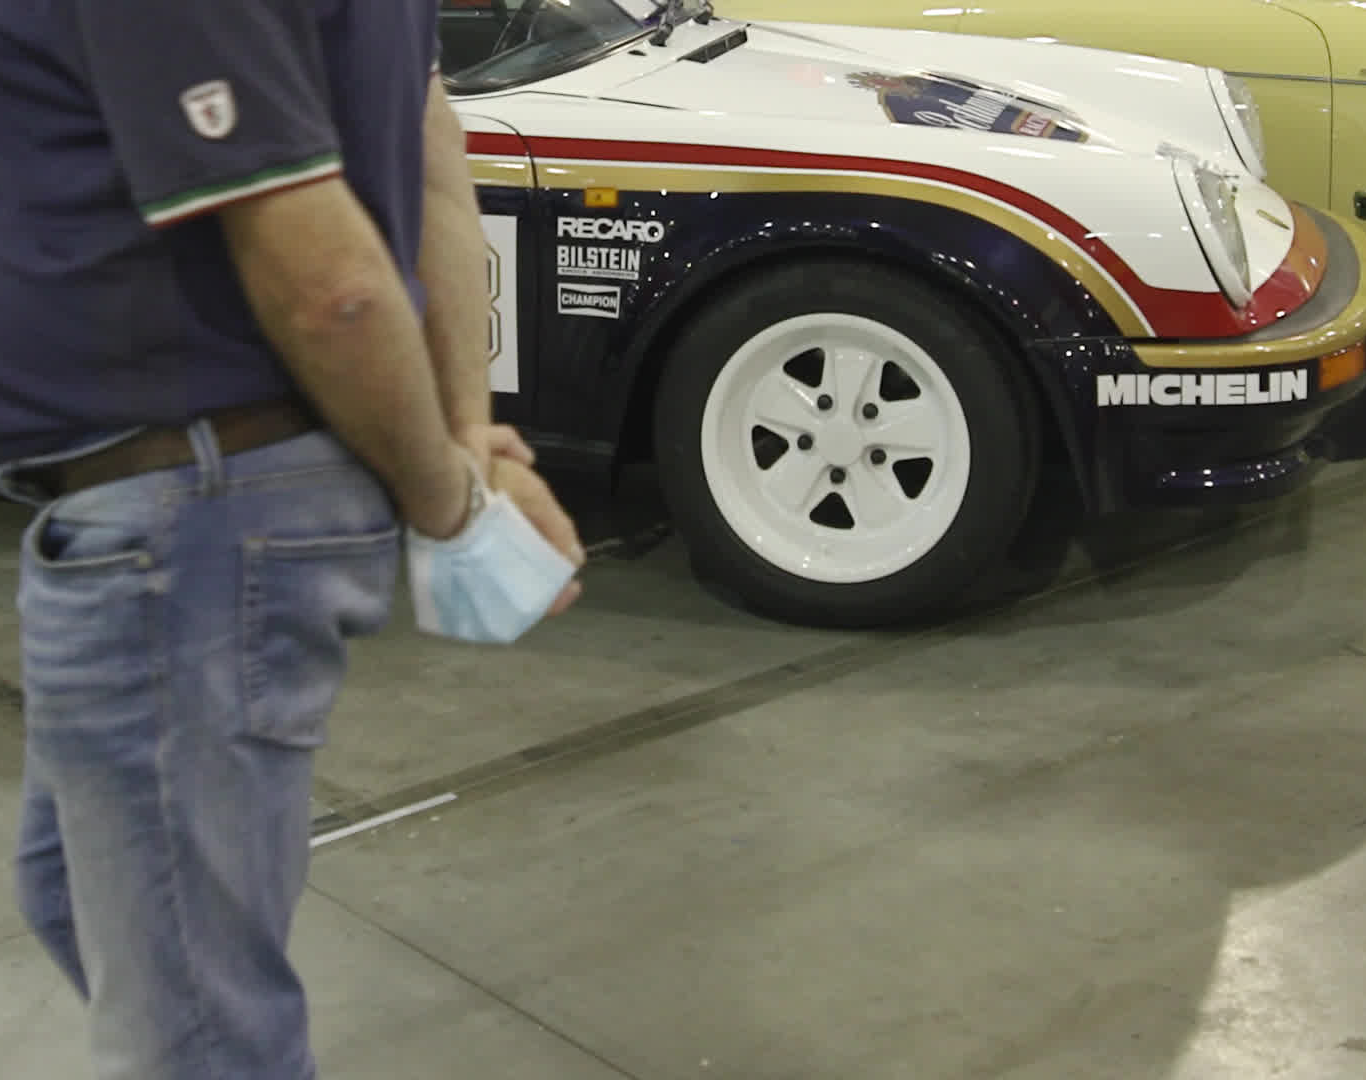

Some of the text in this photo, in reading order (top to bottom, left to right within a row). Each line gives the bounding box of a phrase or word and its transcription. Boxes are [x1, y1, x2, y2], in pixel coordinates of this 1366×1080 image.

[557, 216, 665, 242] RECARO
[557, 245, 641, 271] BILSTEIN
[561, 293, 617, 308] CHAMPION
[1096, 368, 1308, 407] MICHELIN
